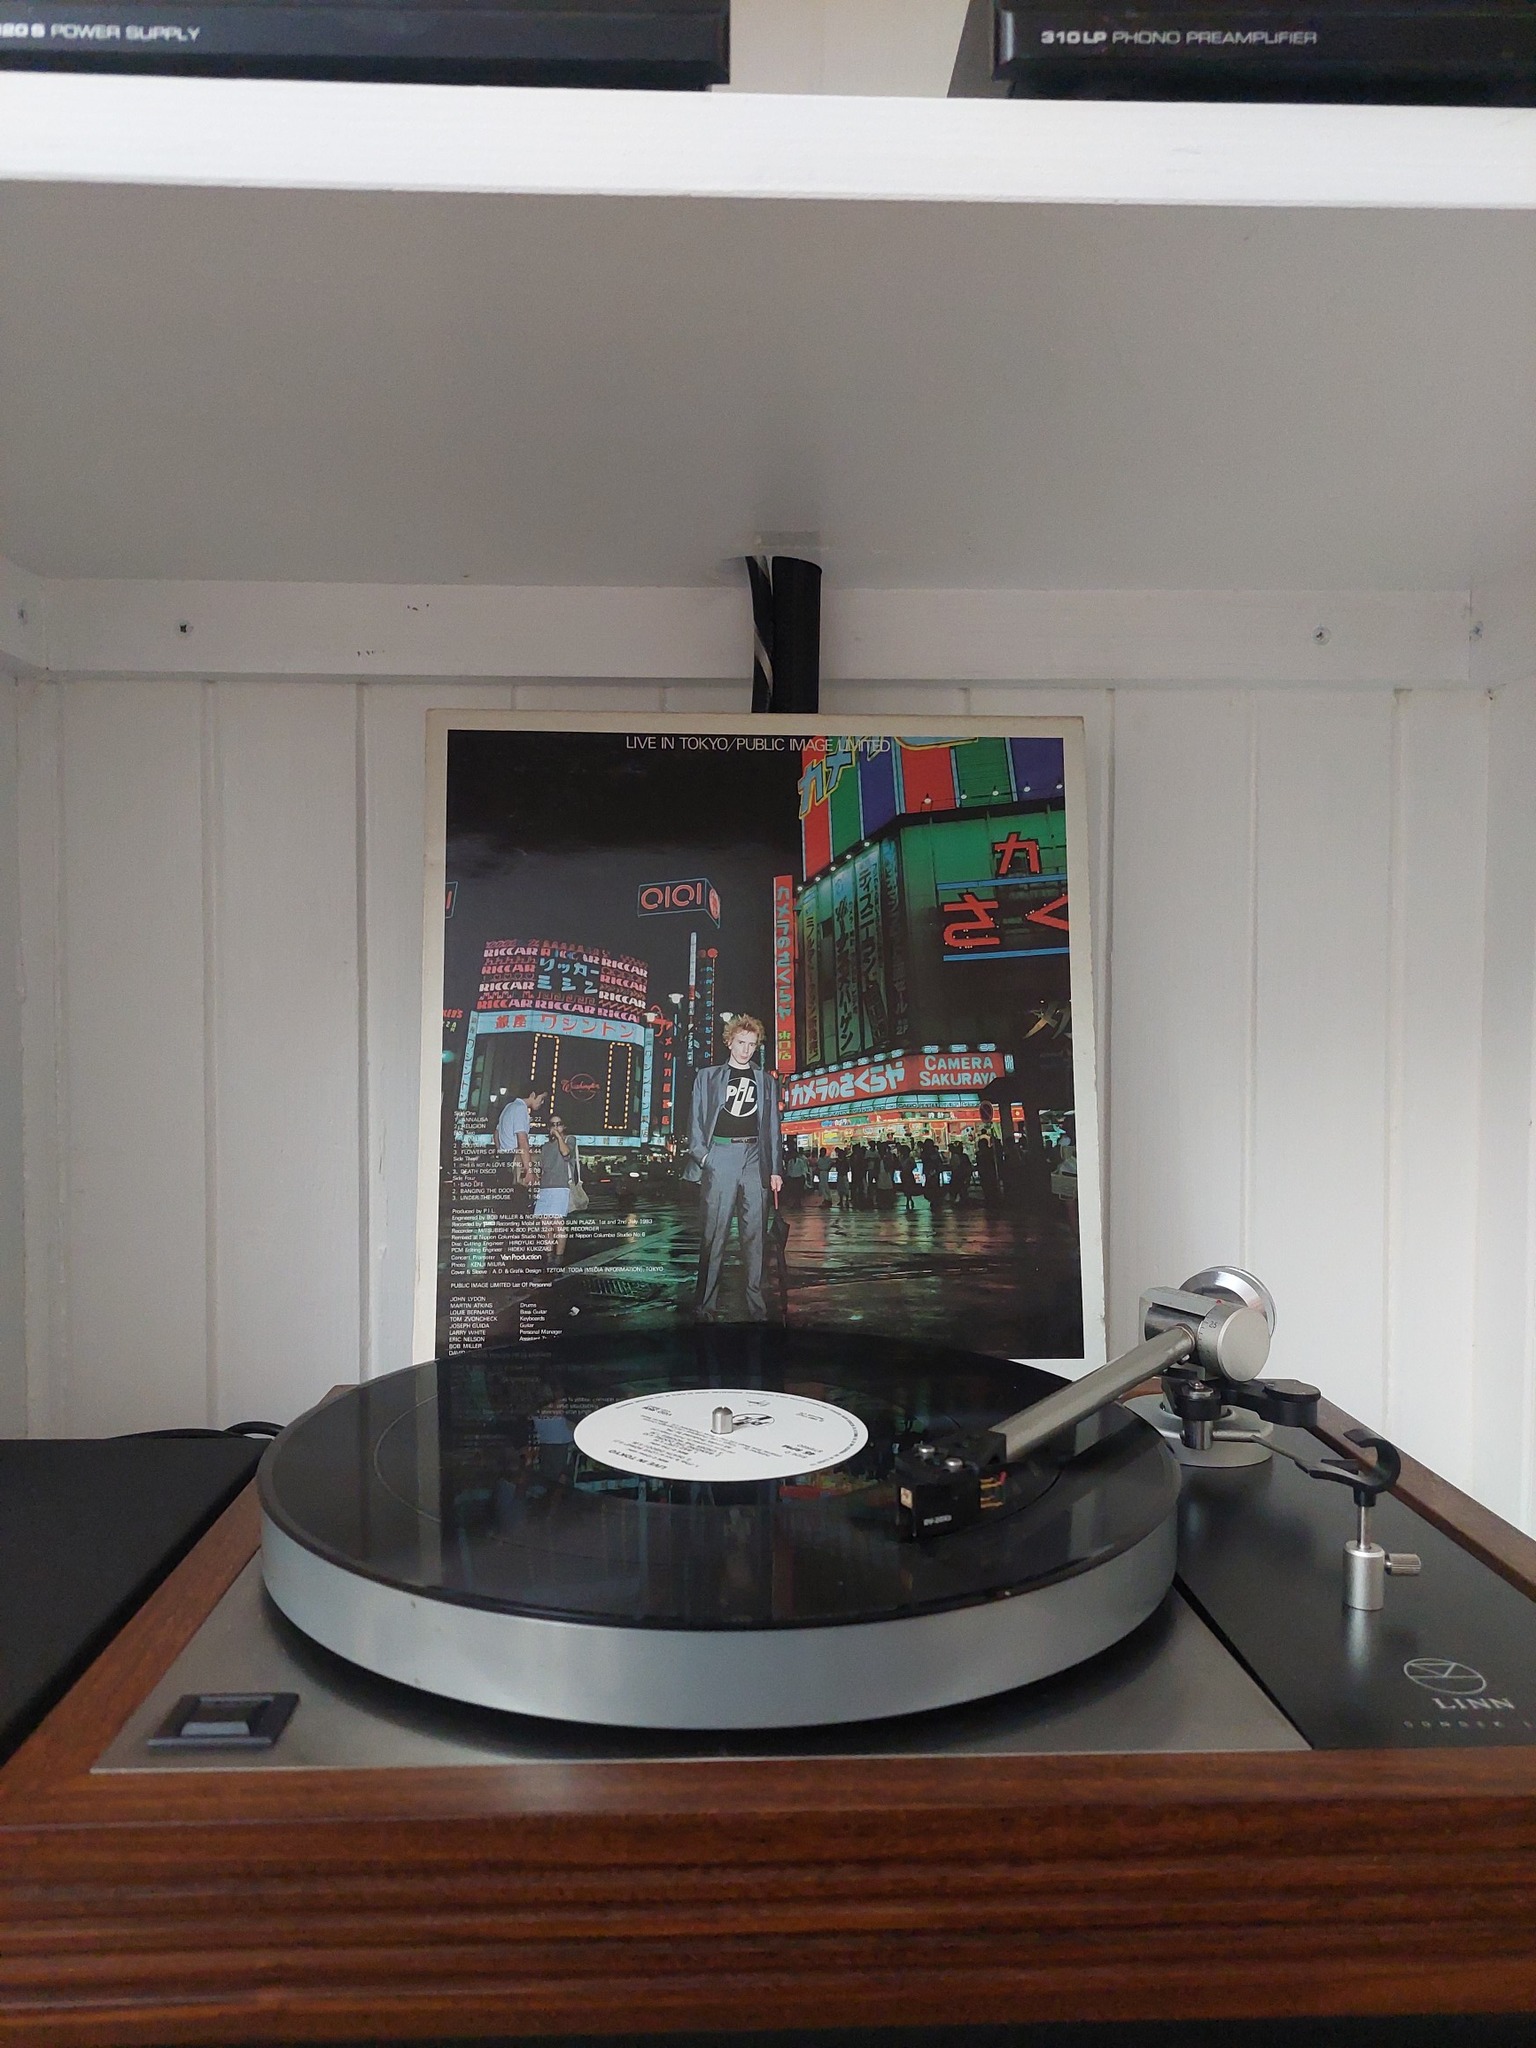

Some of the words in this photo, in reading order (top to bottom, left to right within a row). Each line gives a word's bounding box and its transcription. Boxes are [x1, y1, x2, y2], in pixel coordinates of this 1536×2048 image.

[50, 23, 121, 40] POWER
[125, 24, 201, 42] SUPPLY
[1112, 30, 1180, 45] PHONO
[1186, 30, 1317, 45] PREAMPLIFIER
[626, 736, 656, 749] LIVE
[661, 737, 675, 750] IN
[790, 738, 832, 751] IMAGE
[836, 739, 890, 751] LIMITED
[994, 833, 1040, 874] カ
[481, 964, 536, 975] RICCAR
[484, 947, 538, 958] RICCAR
[601, 958, 648, 978] RICCAR
[479, 981, 535, 992] RICCAR
[600, 974, 647, 993] RICCAR
[476, 999, 533, 1010] RICCAR
[534, 1000, 596, 1014] RICCAR
[598, 990, 646, 1010] RICCAR
[924, 1055, 993, 1071] CAMERA
[791, 1061, 905, 1106] カメラのさくらや
[1432, 1697, 1515, 1710] LINN
